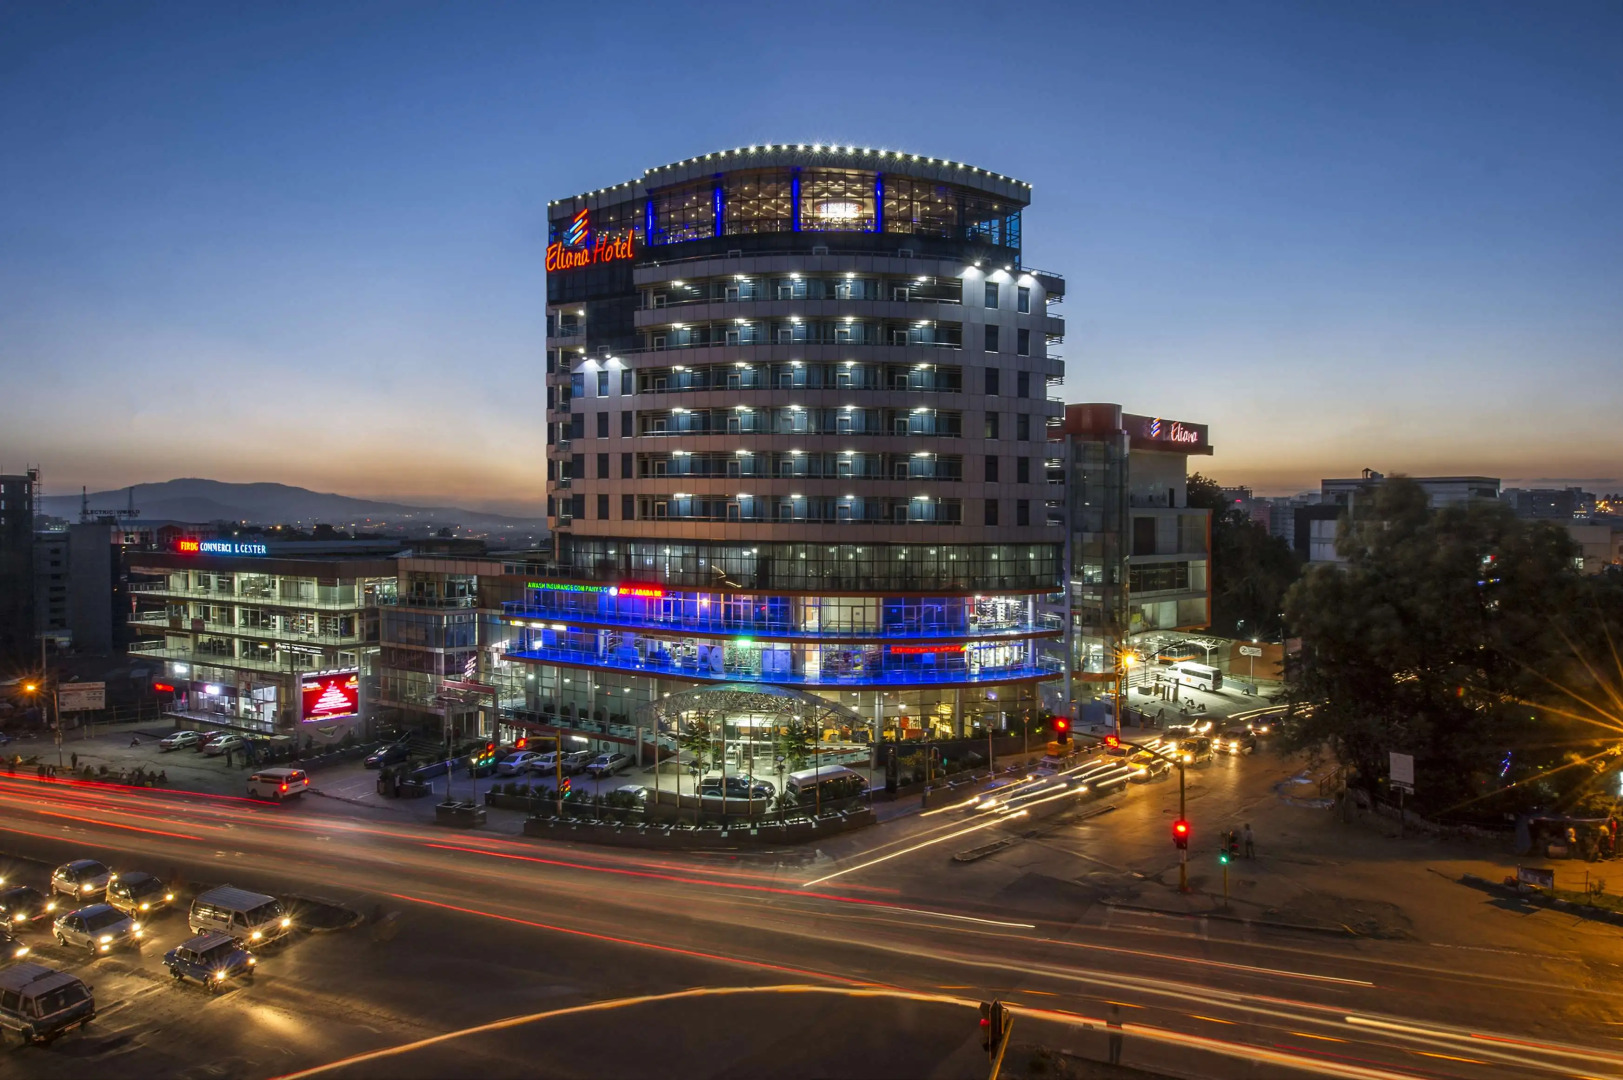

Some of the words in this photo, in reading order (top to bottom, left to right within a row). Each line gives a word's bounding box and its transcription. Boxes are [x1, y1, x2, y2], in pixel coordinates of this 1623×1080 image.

[545, 241, 590, 271] Eliana
[594, 230, 633, 264] Hotel
[1171, 421, 1198, 443] Eliana
[240, 544, 266, 554] CENTER
[546, 583, 573, 591] INSURANCE
